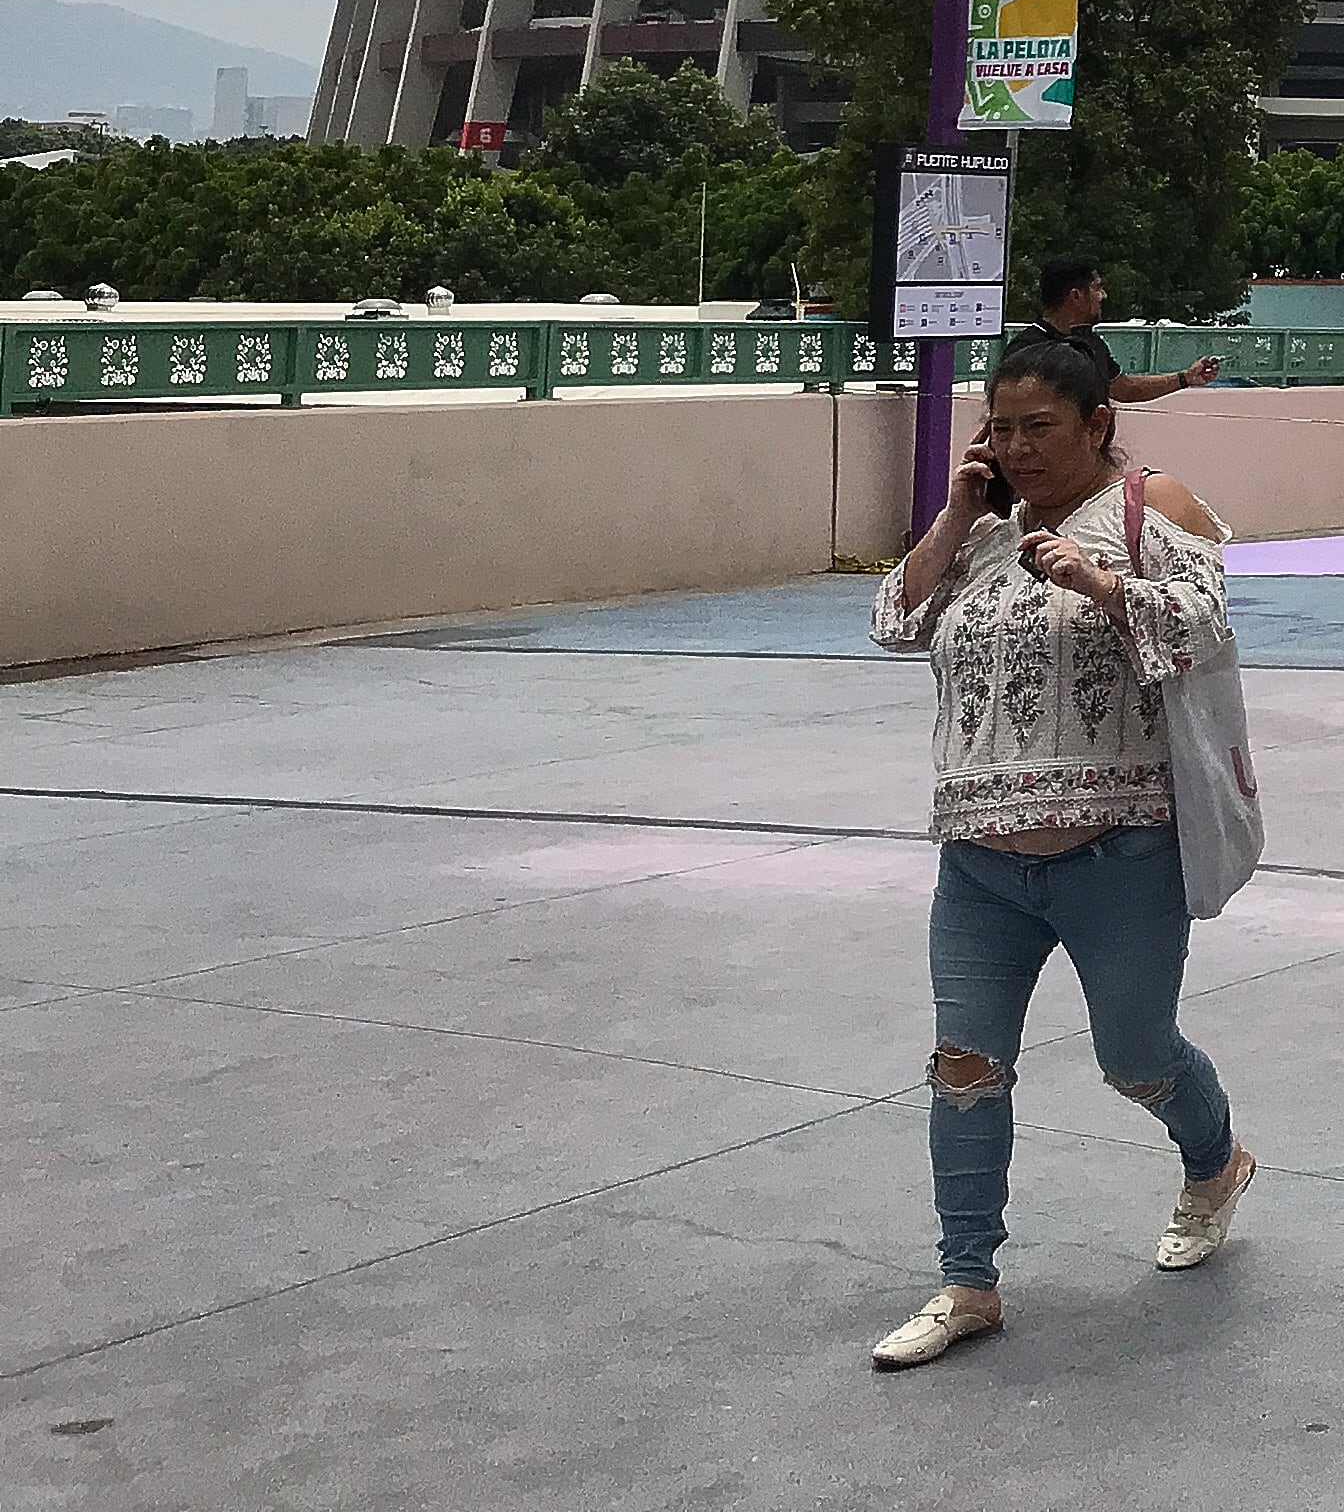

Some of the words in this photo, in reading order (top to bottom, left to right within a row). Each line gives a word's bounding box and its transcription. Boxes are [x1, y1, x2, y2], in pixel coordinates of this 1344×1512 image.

[976, 41, 999, 60] LA
[1003, 39, 1071, 59] PELOTA
[975, 63, 1022, 77] VUELVE
[1025, 63, 1034, 76] A
[1037, 62, 1069, 76] CASA
[917, 153, 958, 168] PUENTE
